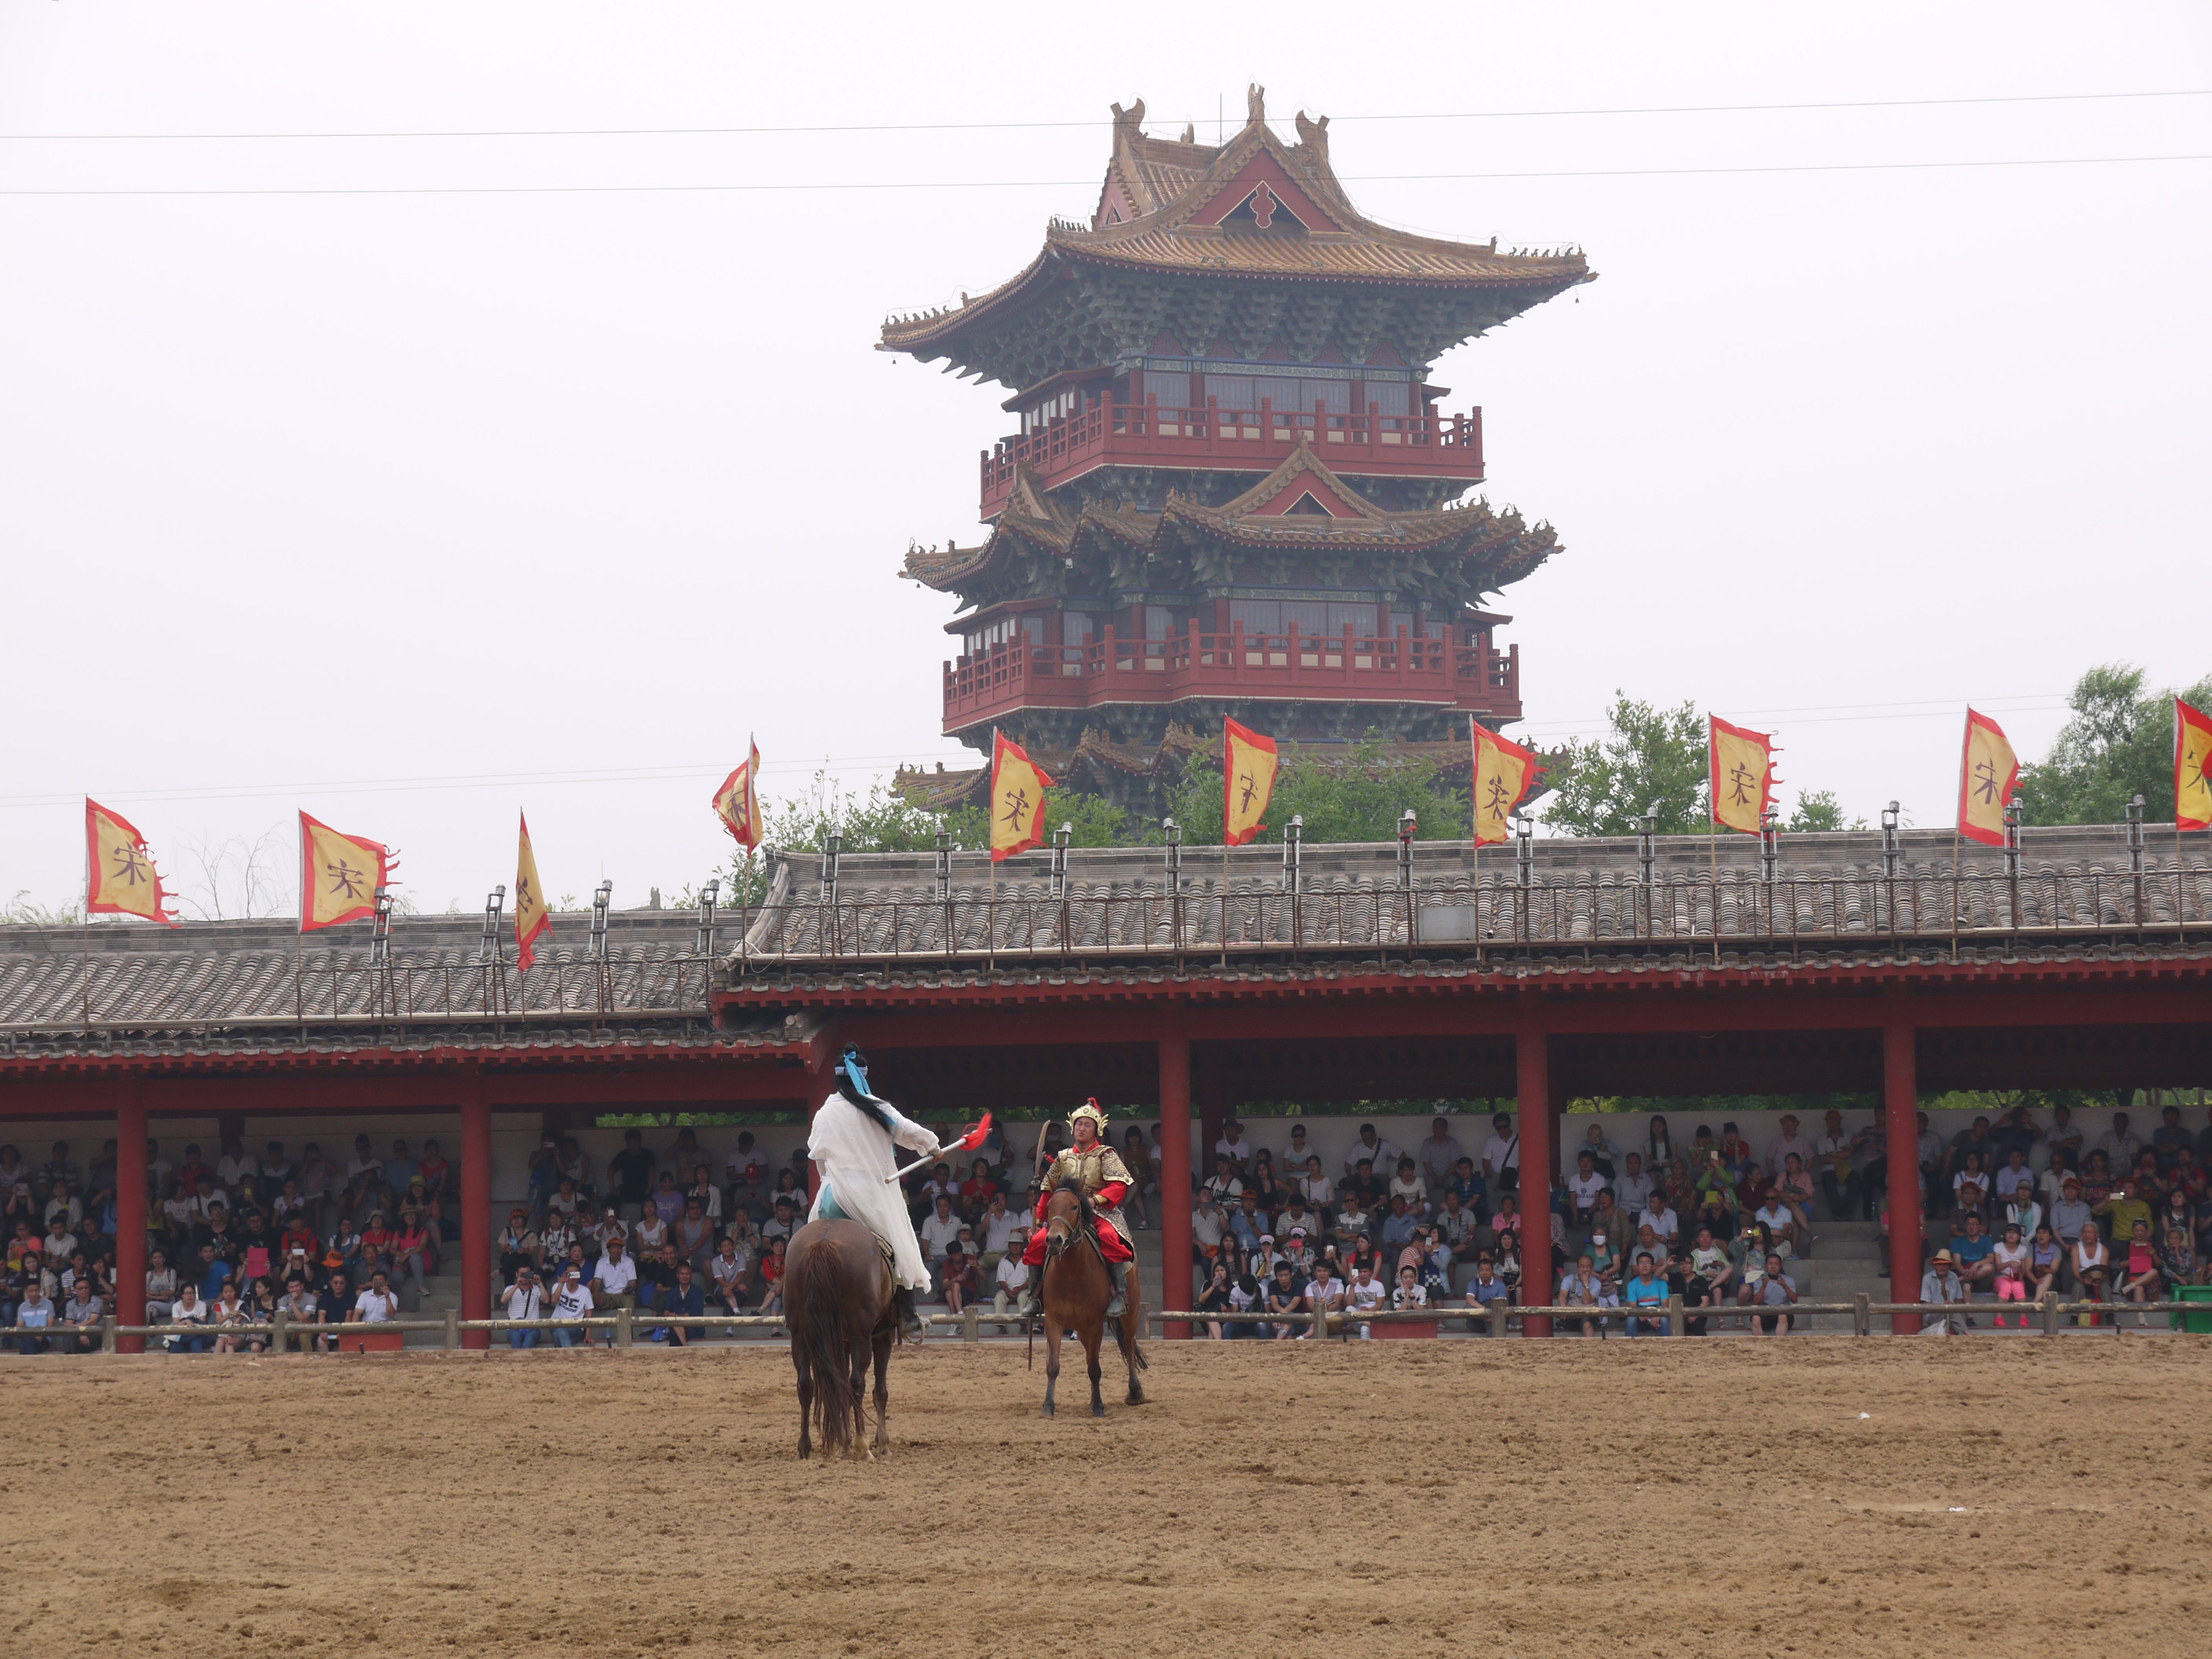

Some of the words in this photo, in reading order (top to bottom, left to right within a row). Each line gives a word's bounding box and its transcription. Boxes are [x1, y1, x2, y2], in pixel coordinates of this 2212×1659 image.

[1240, 770, 1258, 814] 宋
[1482, 774, 1510, 821] 宋
[1728, 761, 1756, 807] 宋
[1973, 759, 2001, 805] 宋
[1000, 788, 1030, 832] 宋
[113, 842, 148, 886] 宋
[327, 858, 364, 899] 宋
